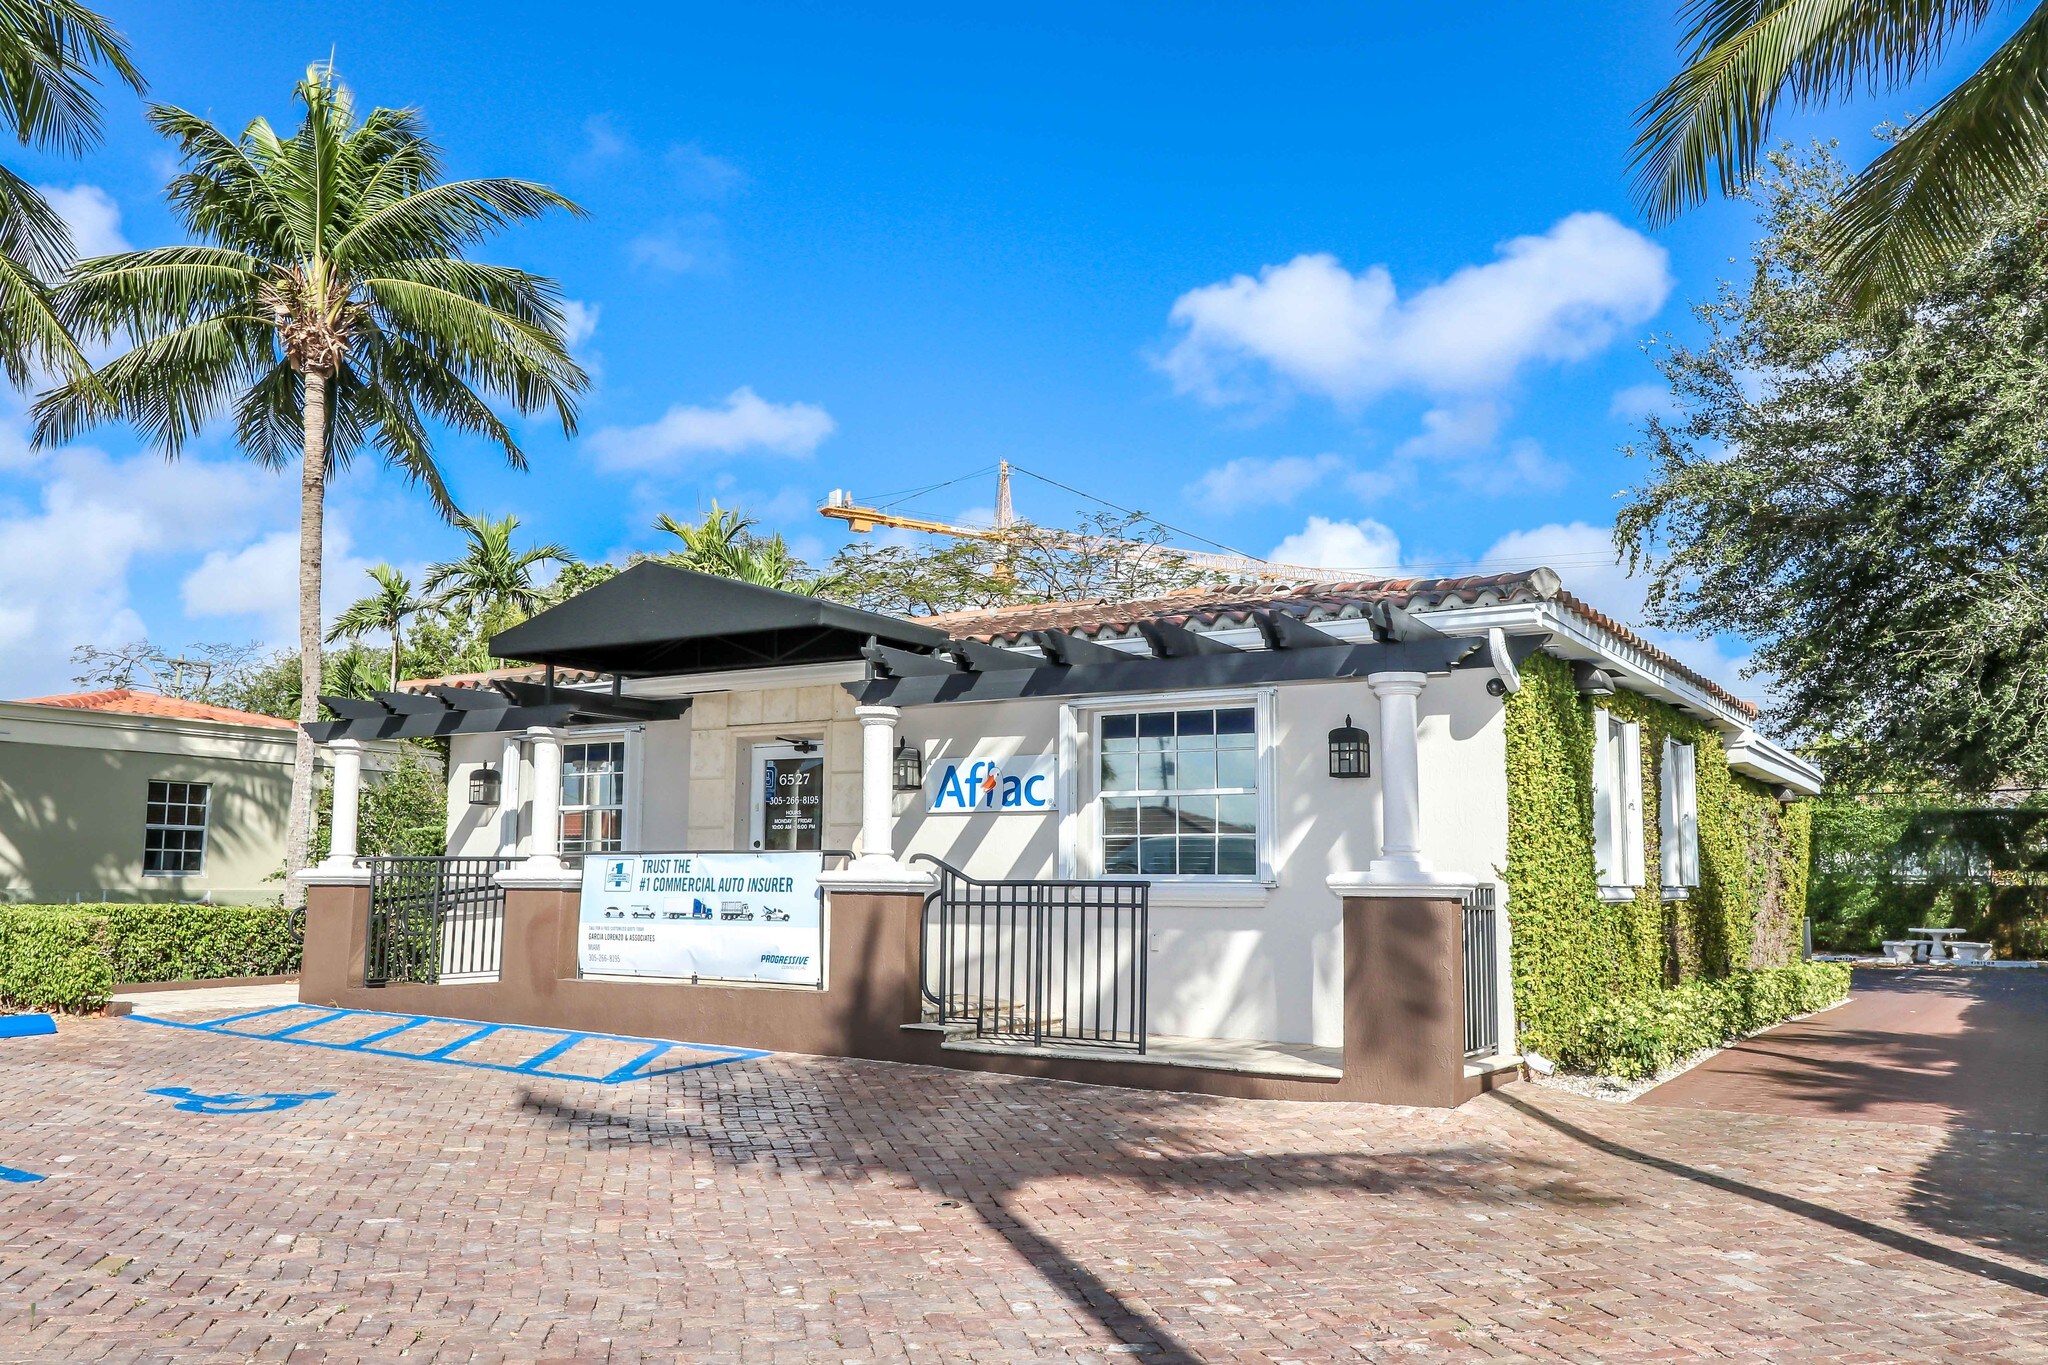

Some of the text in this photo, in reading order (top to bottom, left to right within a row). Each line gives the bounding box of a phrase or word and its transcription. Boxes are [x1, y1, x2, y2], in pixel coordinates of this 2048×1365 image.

[779, 774, 810, 785] 6527
[934, 761, 1046, 808] Aflac
[770, 796, 819, 805] 305-266-8195
[642, 859, 691, 874] TRUST THE
[639, 877, 650, 892] #1
[653, 877, 716, 892] COMMERCIAL
[718, 877, 744, 892] AUTO
[747, 877, 793, 893] INSURER
[605, 933, 623, 941] LORENZO
[629, 934, 655, 942] ASSOCIATES
[760, 954, 810, 965] PROGRESSIVE
